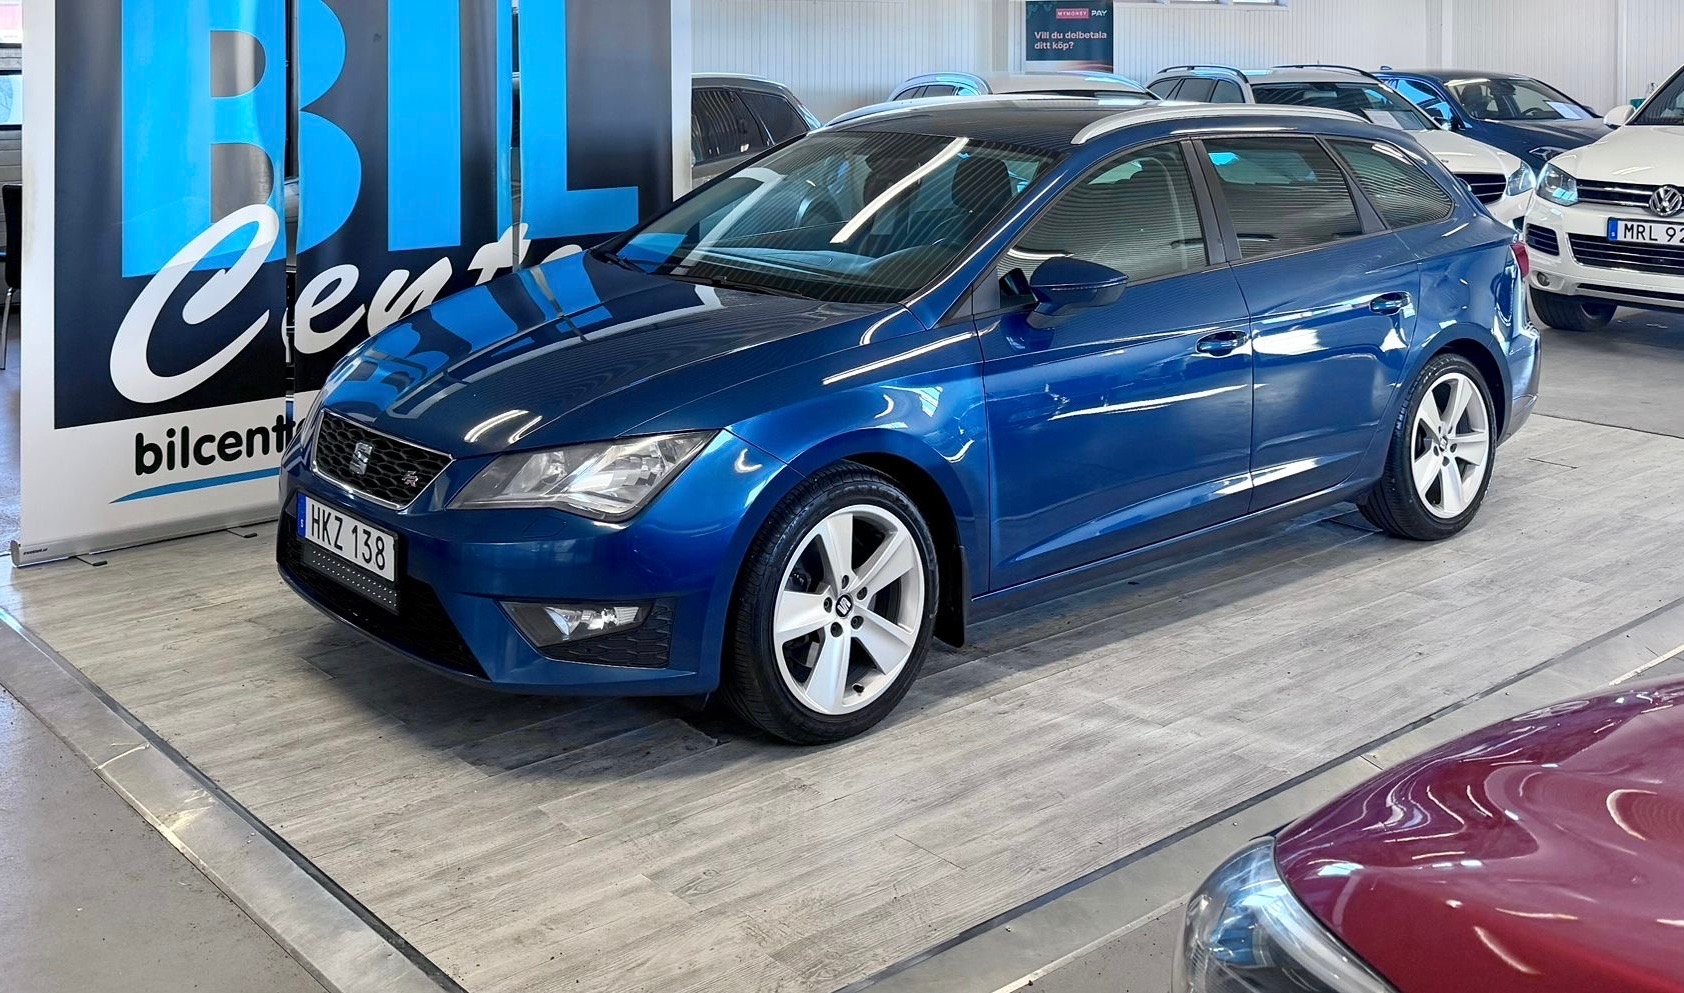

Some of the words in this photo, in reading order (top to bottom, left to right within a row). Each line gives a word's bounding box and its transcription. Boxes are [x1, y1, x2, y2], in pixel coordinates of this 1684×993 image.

[1034, 31, 1050, 39] Vill
[1051, 31, 1063, 39] du
[1065, 31, 1107, 39] delbetala
[1052, 41, 1075, 50] köp?
[122, 0, 638, 278] BIL
[1623, 223, 1658, 241] MRL
[110, 203, 583, 404] Cent
[135, 415, 305, 476] bilcent
[311, 504, 343, 551] HKZ
[352, 525, 386, 571] 138
